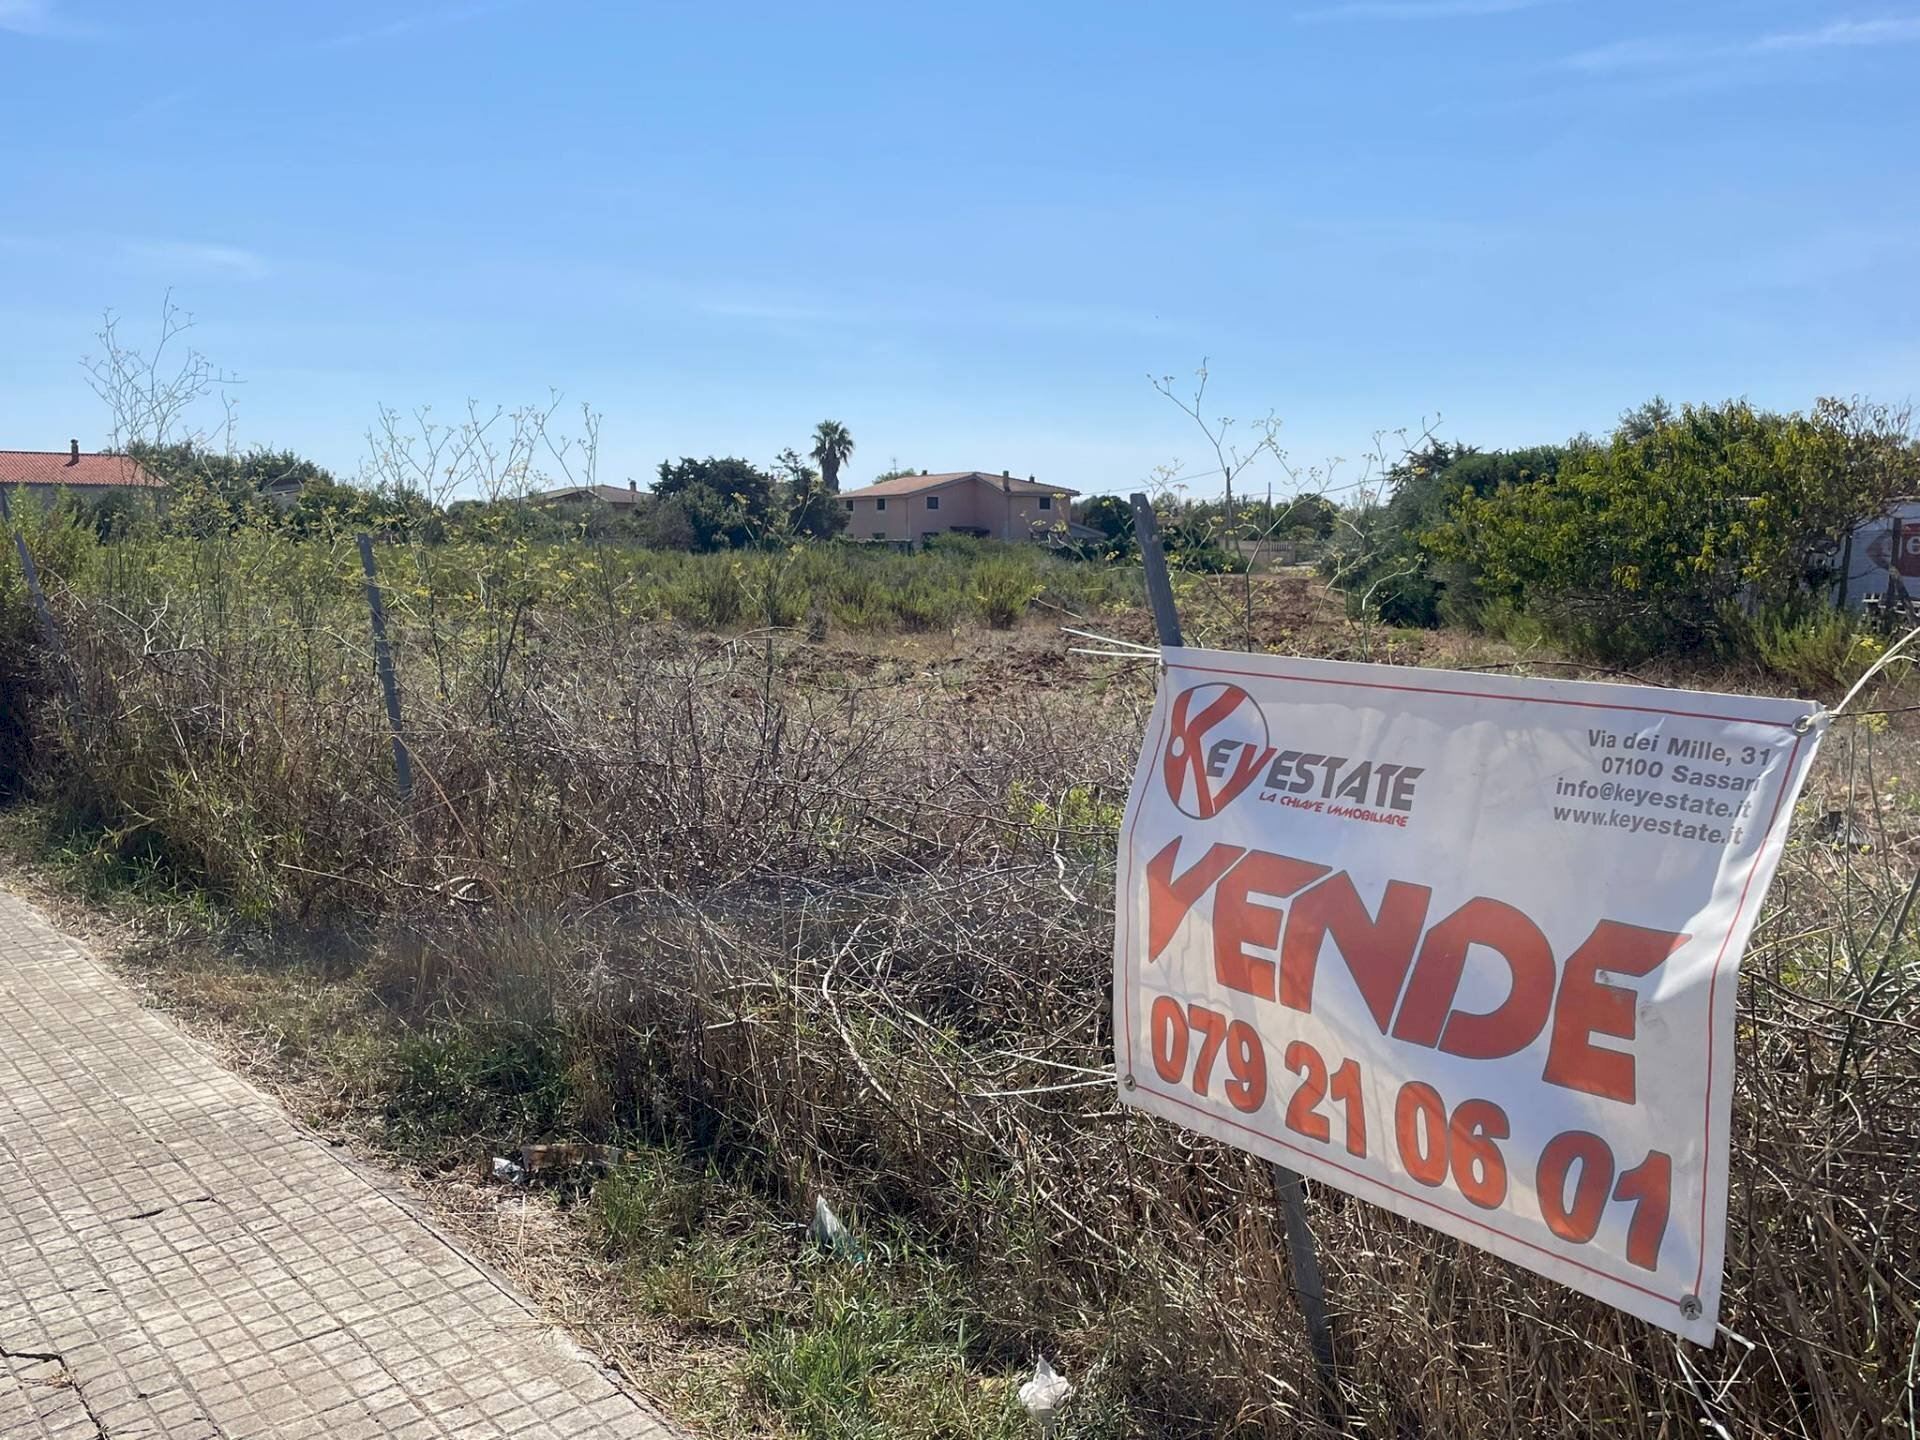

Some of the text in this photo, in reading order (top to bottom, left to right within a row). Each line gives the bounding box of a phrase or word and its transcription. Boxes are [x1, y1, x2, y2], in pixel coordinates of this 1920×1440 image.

[1588, 729, 1771, 767] Via dei Mille, 31
[1601, 756, 1664, 779] 07100
[1259, 791, 1410, 828] LA CHIAVE IMMOBILIARE
[1555, 777, 1752, 819] info@keyestate.it
[1553, 806, 1744, 845] www.keyestate.it
[1147, 835, 1692, 1105] VENDE
[1150, 995, 1673, 1273] 079 21 06 01
